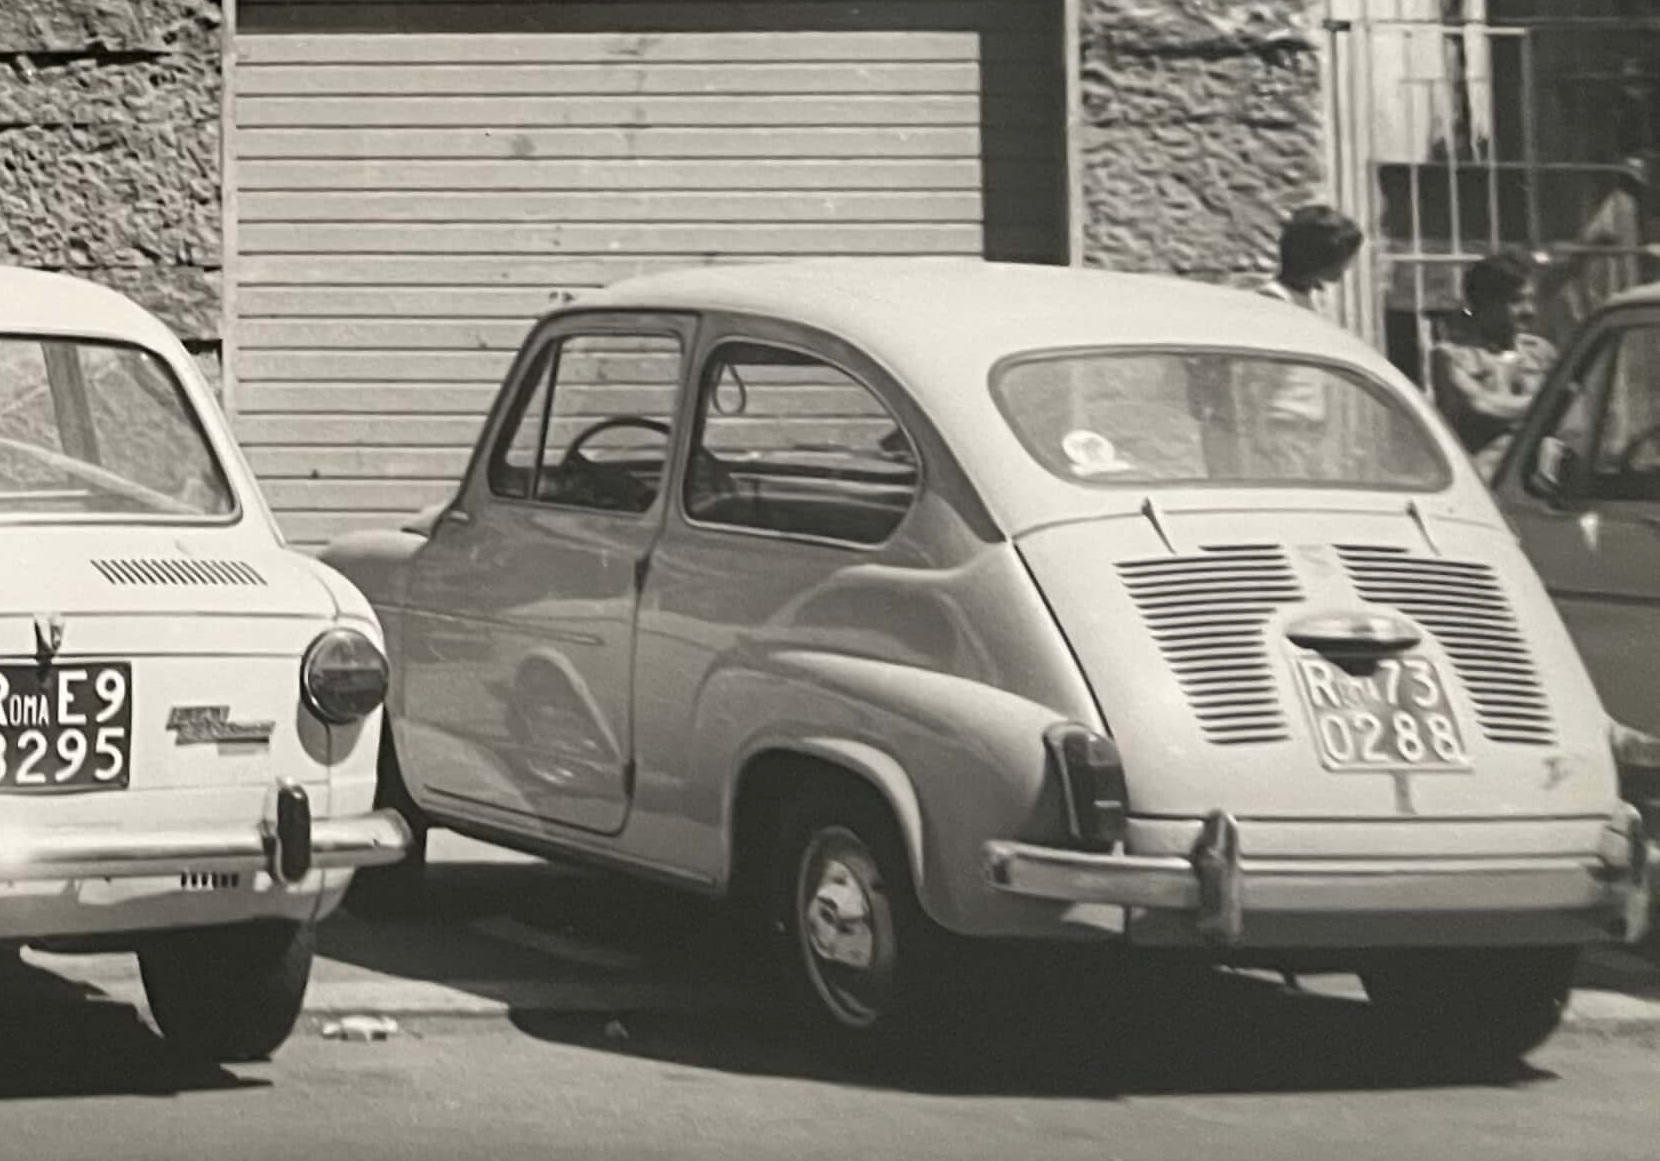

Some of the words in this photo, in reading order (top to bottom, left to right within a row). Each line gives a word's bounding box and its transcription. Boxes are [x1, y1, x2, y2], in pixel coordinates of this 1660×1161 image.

[57, 669, 127, 726] E9
[1379, 659, 1441, 709] 73
[1319, 711, 1462, 765] 0288
